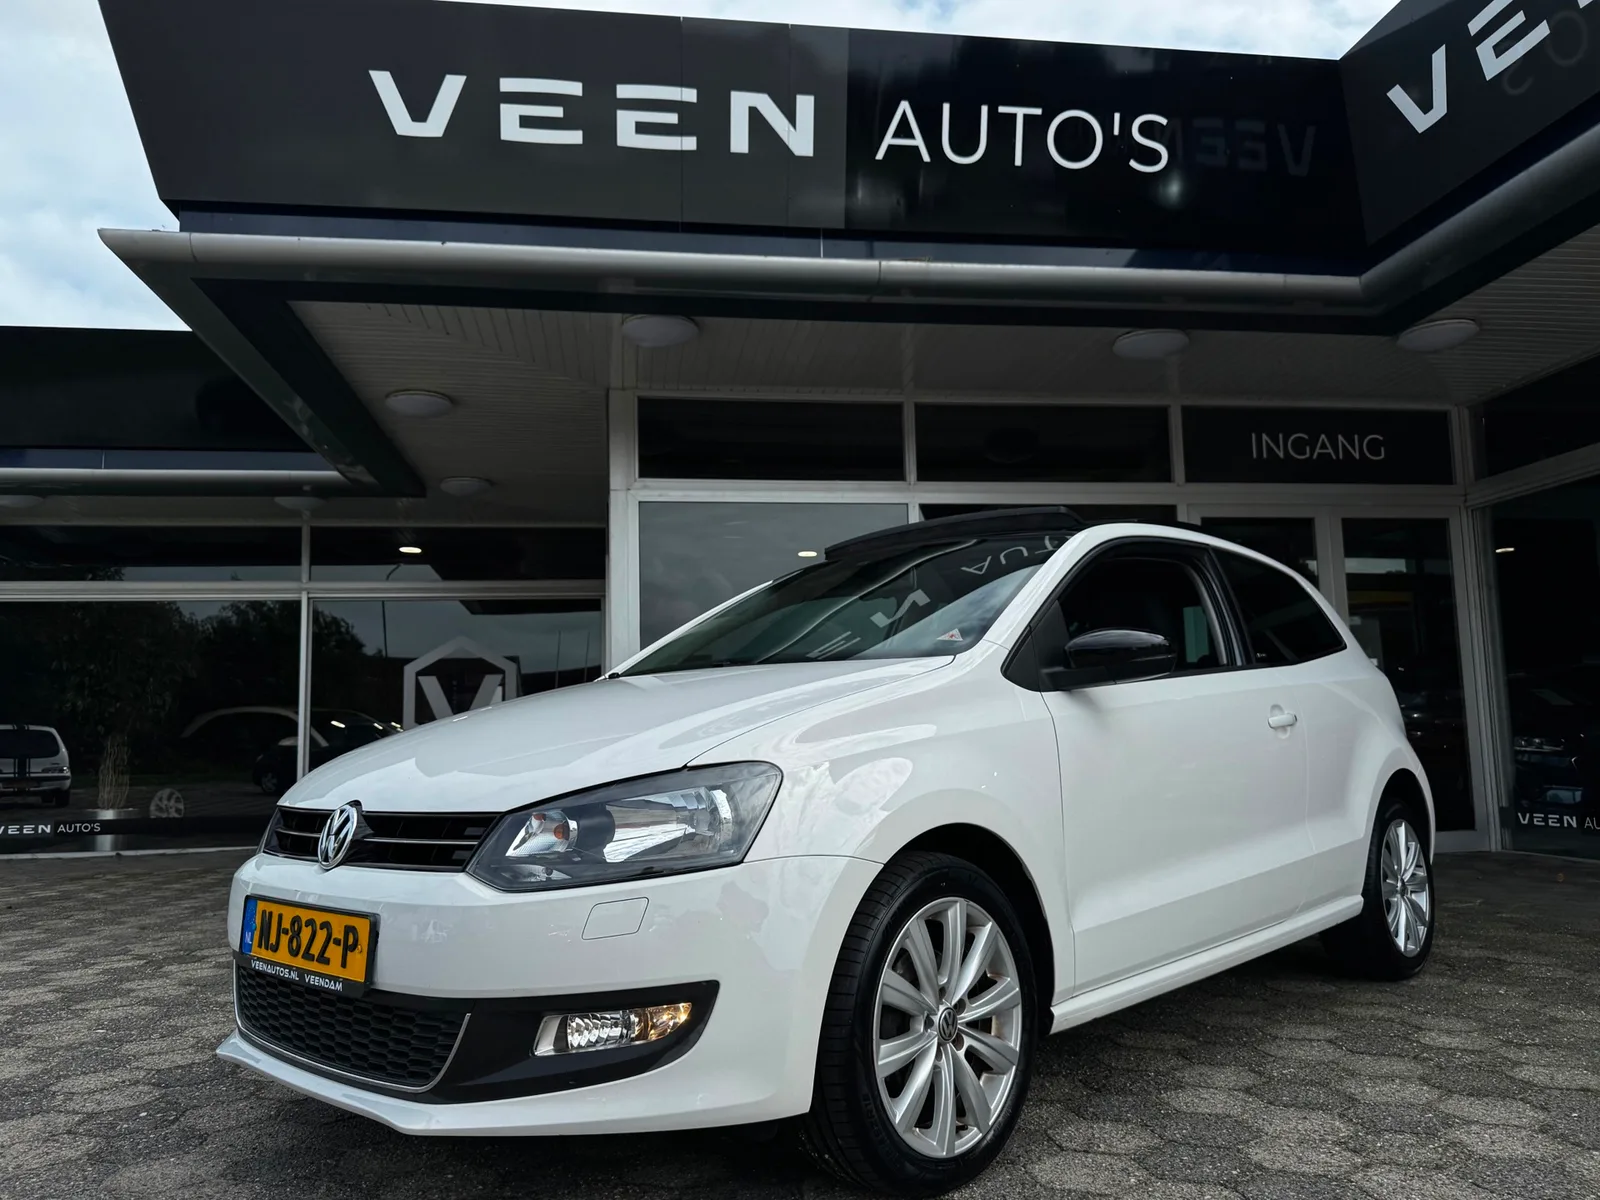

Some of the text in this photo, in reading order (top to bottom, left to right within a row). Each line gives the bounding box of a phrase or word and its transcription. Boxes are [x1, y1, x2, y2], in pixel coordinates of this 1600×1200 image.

[1386, 0, 1594, 134] VE
[368, 70, 1169, 173] VEEN AUTO'S
[1251, 432, 1385, 460] INGANG
[57, 823, 101, 833] AUTO'S
[1517, 812, 1577, 828] VEEN
[245, 931, 252, 944] NL
[257, 909, 359, 969] NJ-822-P
[251, 959, 343, 992] VEENAUTOS.NL VEENDAM
